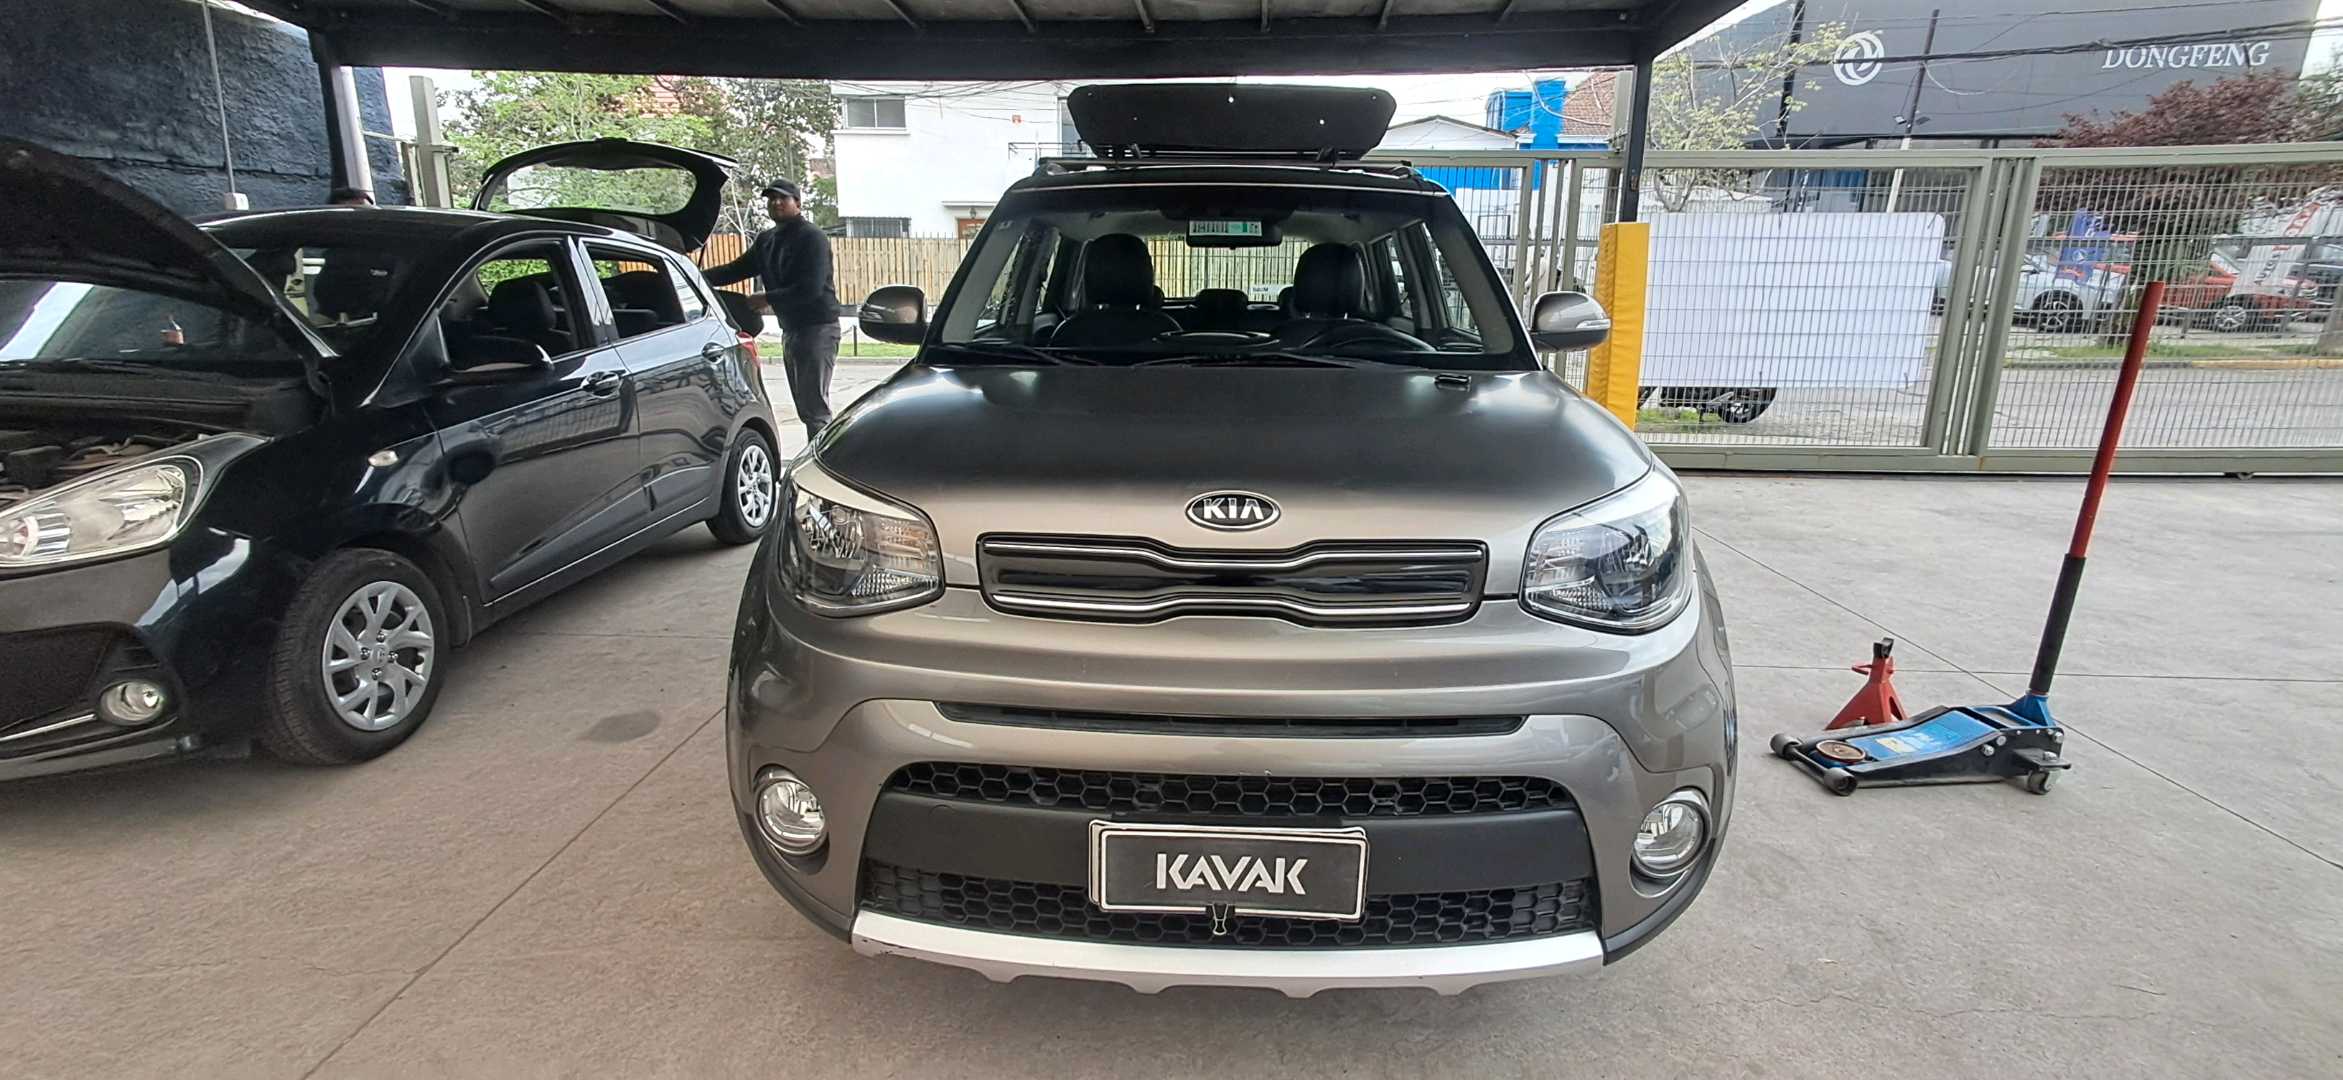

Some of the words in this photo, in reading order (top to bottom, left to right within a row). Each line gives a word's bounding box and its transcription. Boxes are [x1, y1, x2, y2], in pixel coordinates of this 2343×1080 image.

[2101, 41, 2271, 69] DONGFENG
[1203, 498, 1264, 520] KIA
[1156, 853, 1308, 895] KAVAK
